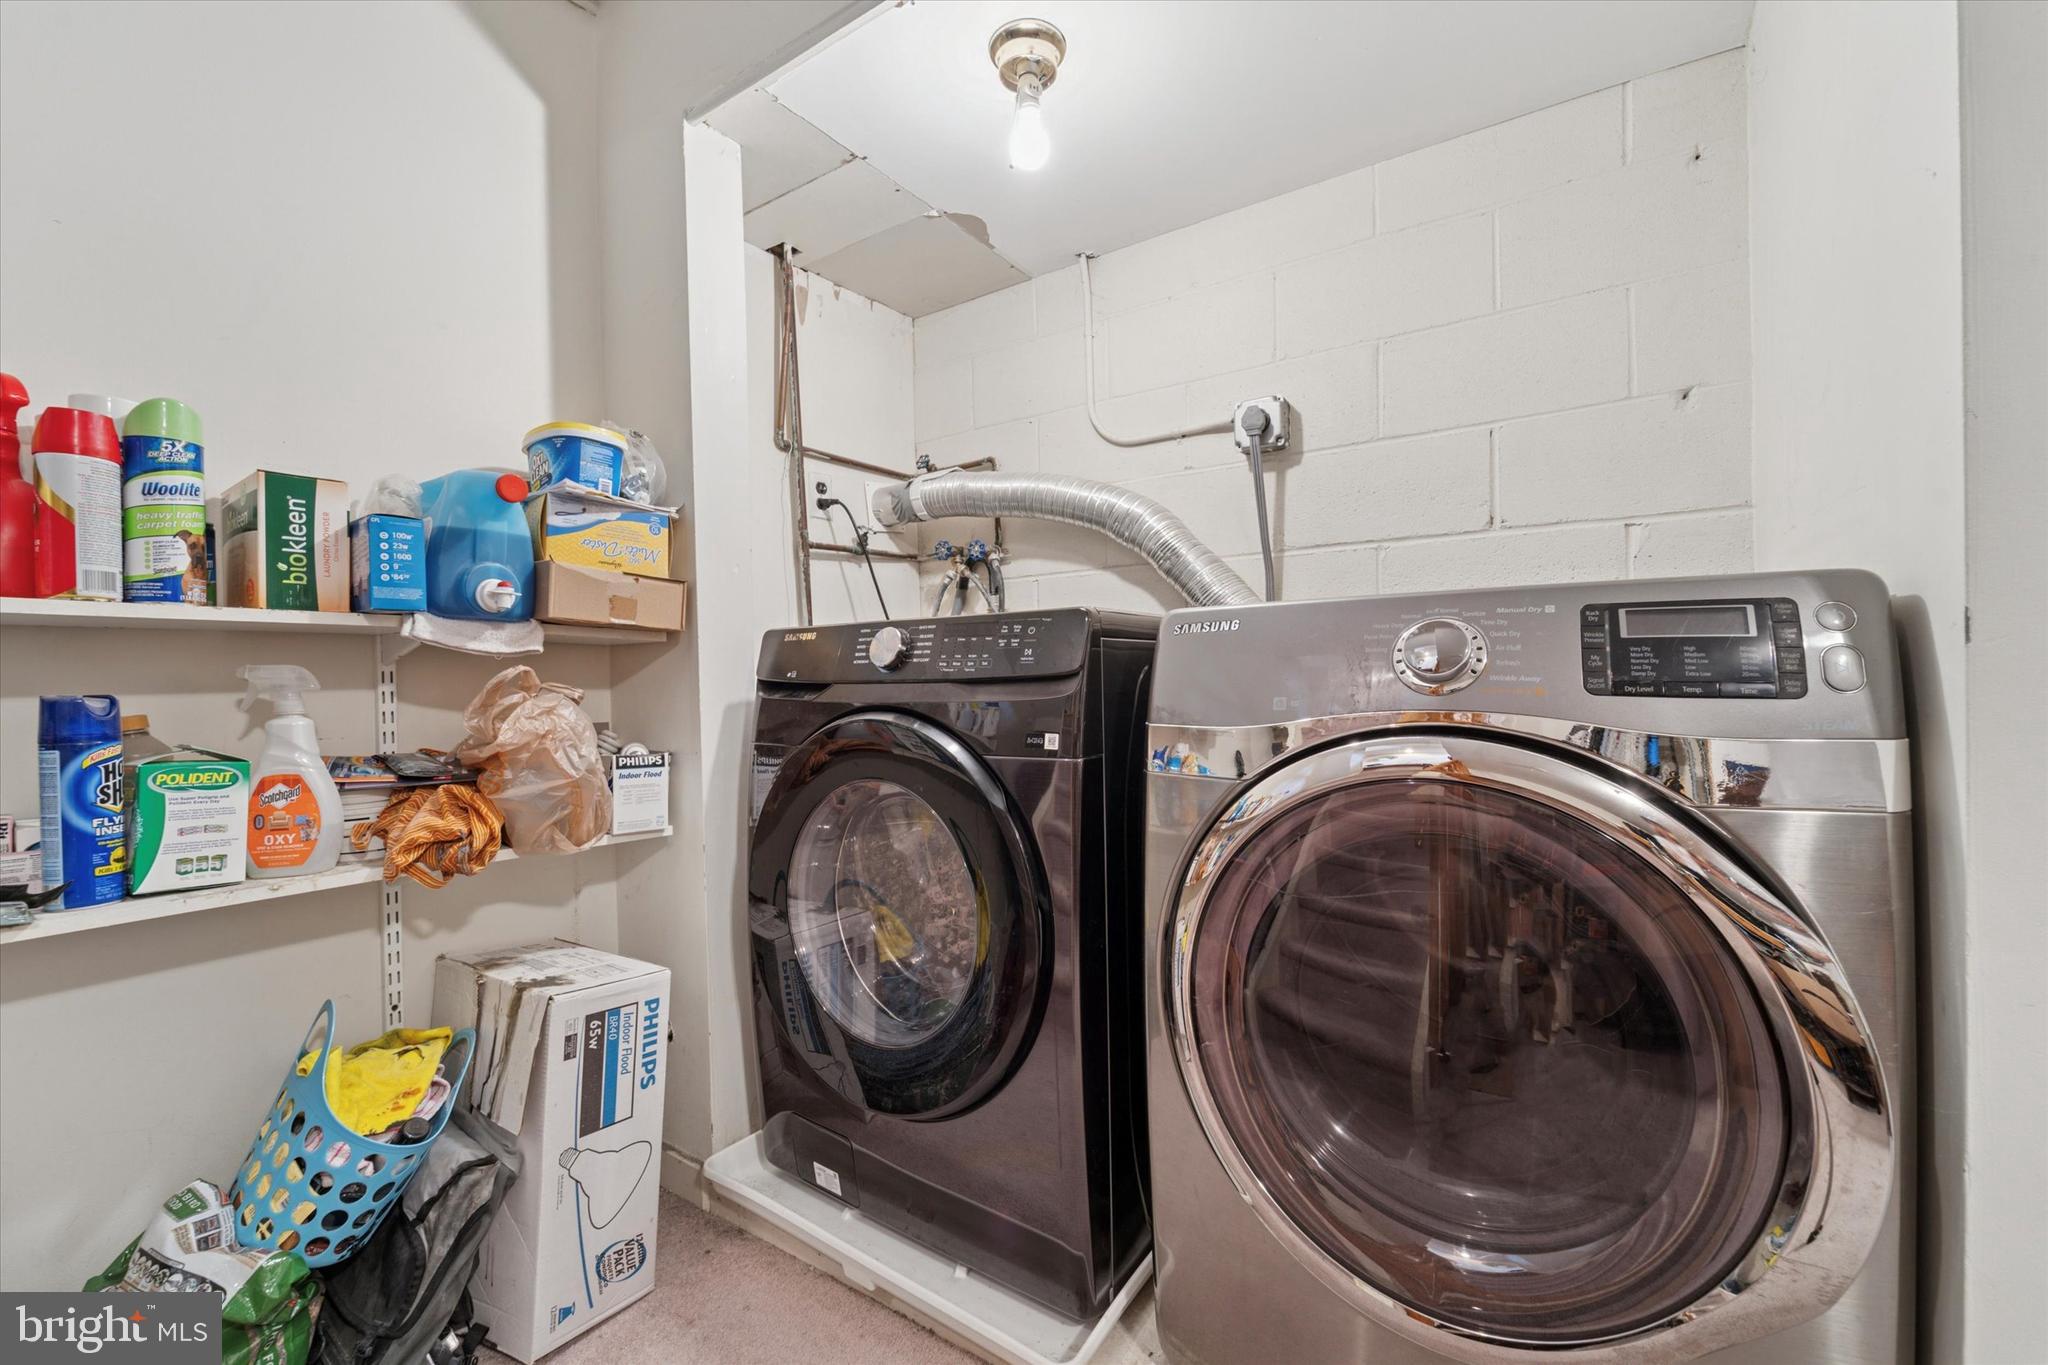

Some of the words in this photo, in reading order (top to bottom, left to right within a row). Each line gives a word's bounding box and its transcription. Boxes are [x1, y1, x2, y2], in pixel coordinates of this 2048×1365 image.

[160, 440, 185, 452] 5X
[141, 482, 201, 497] Woolite
[136, 511, 173, 521] heavy
[136, 520, 177, 530] carpet
[322, 511, 331, 542] POWDER
[280, 498, 307, 585] biokleen
[580, 537, 622, 557] Duster
[622, 541, 662, 564] Multi
[322, 543, 332, 579] LAUNDRY
[1527, 606, 1543, 614] Dry
[1173, 619, 1240, 635] SAMSUNG
[1489, 630, 1508, 638] Quick
[1509, 630, 1521, 638] Dry
[1587, 660, 1603, 668] Cycle
[1624, 685, 1636, 693] Dry
[618, 755, 664, 767] PHILIPS
[155, 771, 234, 786] POLIDENT
[618, 772, 642, 780] Indoor
[642, 770, 663, 778] Flood
[259, 784, 302, 807] Scotchgard
[264, 833, 297, 846] OXY
[608, 1014, 619, 1041] BR40
[620, 1011, 634, 1044] Indoor
[640, 997, 660, 1091] PHILIPS
[620, 1045, 633, 1076] Flood
[612, 1247, 626, 1279] PACK
[623, 1238, 638, 1273] VALUE
